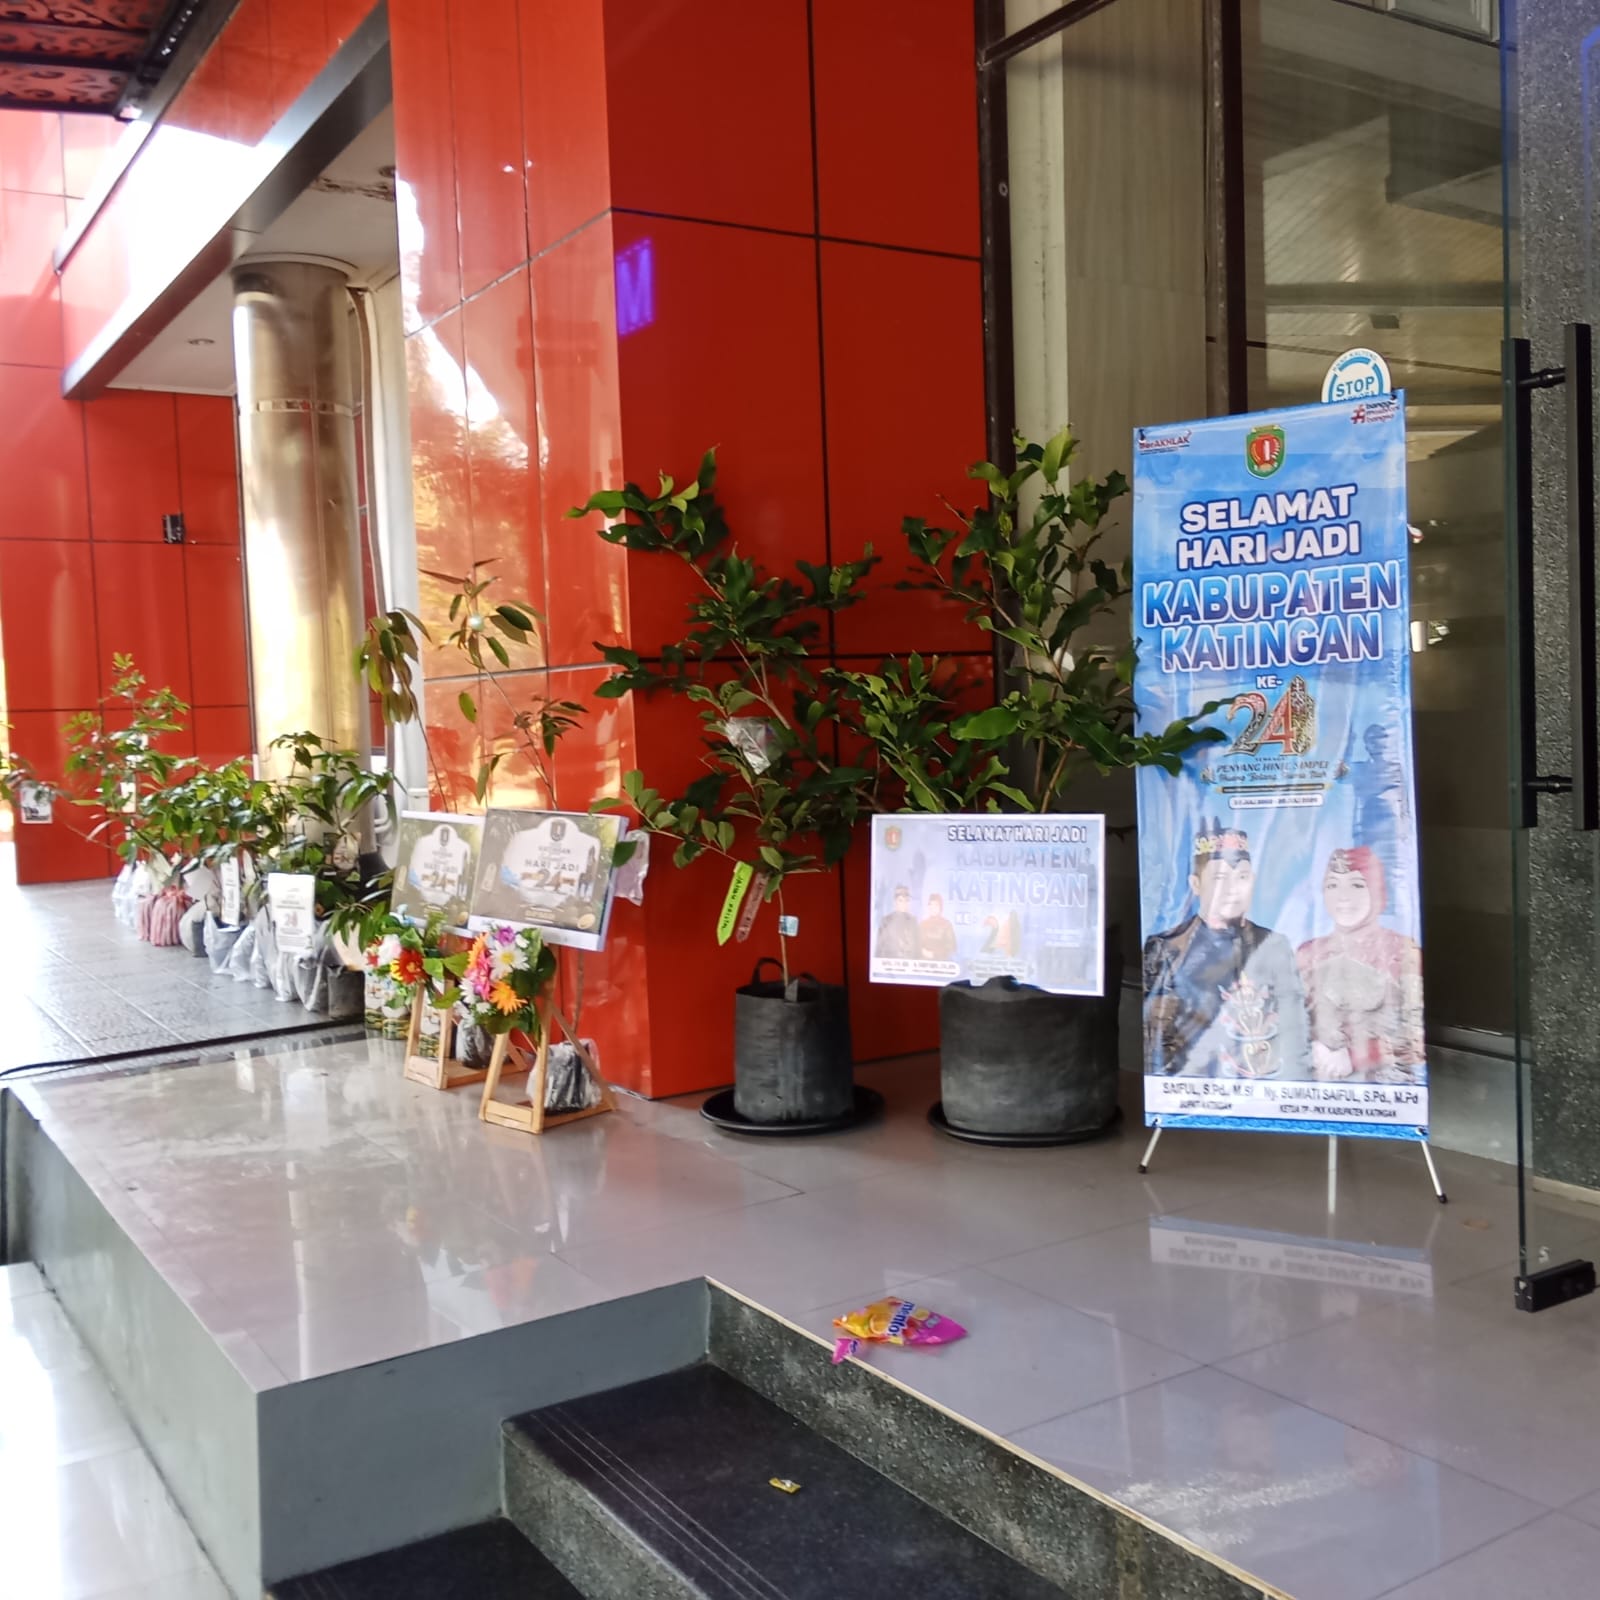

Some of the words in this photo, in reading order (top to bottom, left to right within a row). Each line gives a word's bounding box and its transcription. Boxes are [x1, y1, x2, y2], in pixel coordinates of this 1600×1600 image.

[1336, 376, 1375, 398] STOP
[1181, 484, 1357, 534] SELAMAT
[1177, 533, 1267, 571] HARI
[1271, 522, 1360, 563] JADI
[1142, 559, 1401, 627] KABUPATEN
[1161, 612, 1383, 673] KATINGAN
[1223, 677, 1310, 757] 24
[948, 825, 1012, 842] SELAMAT
[1014, 825, 1048, 843] HARI
[1050, 826, 1087, 843] JADI
[525, 859, 551, 869] HARI
[554, 863, 580, 872] JADI
[957, 846, 1077, 868] KABUPATEN
[948, 870, 1088, 908] KATINGAN
